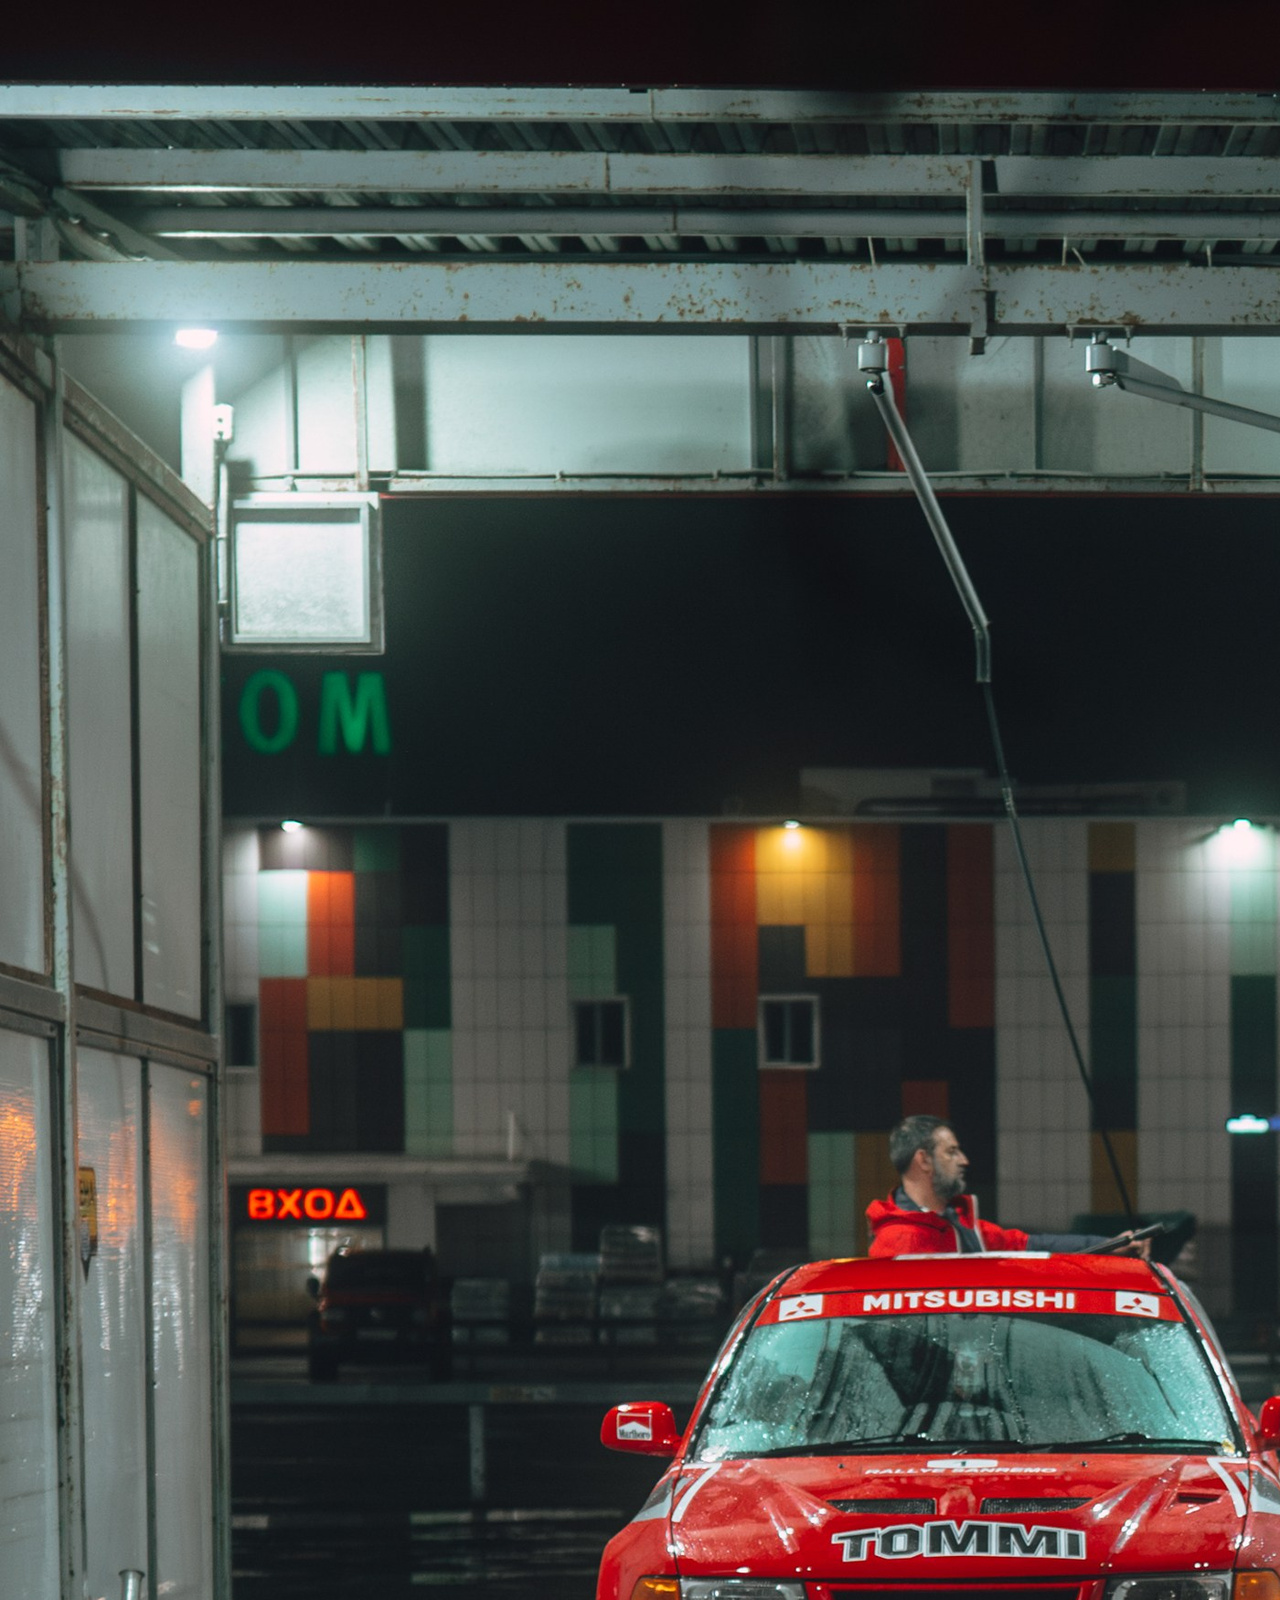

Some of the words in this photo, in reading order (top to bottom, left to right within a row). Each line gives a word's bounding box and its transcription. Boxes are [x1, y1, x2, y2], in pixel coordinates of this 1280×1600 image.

[248, 1187, 367, 1219] ВХОД
[863, 1290, 1076, 1312] MITSUBISHI
[619, 1428, 651, 1439] Marlboro
[831, 1520, 1087, 1562] TOMMI
